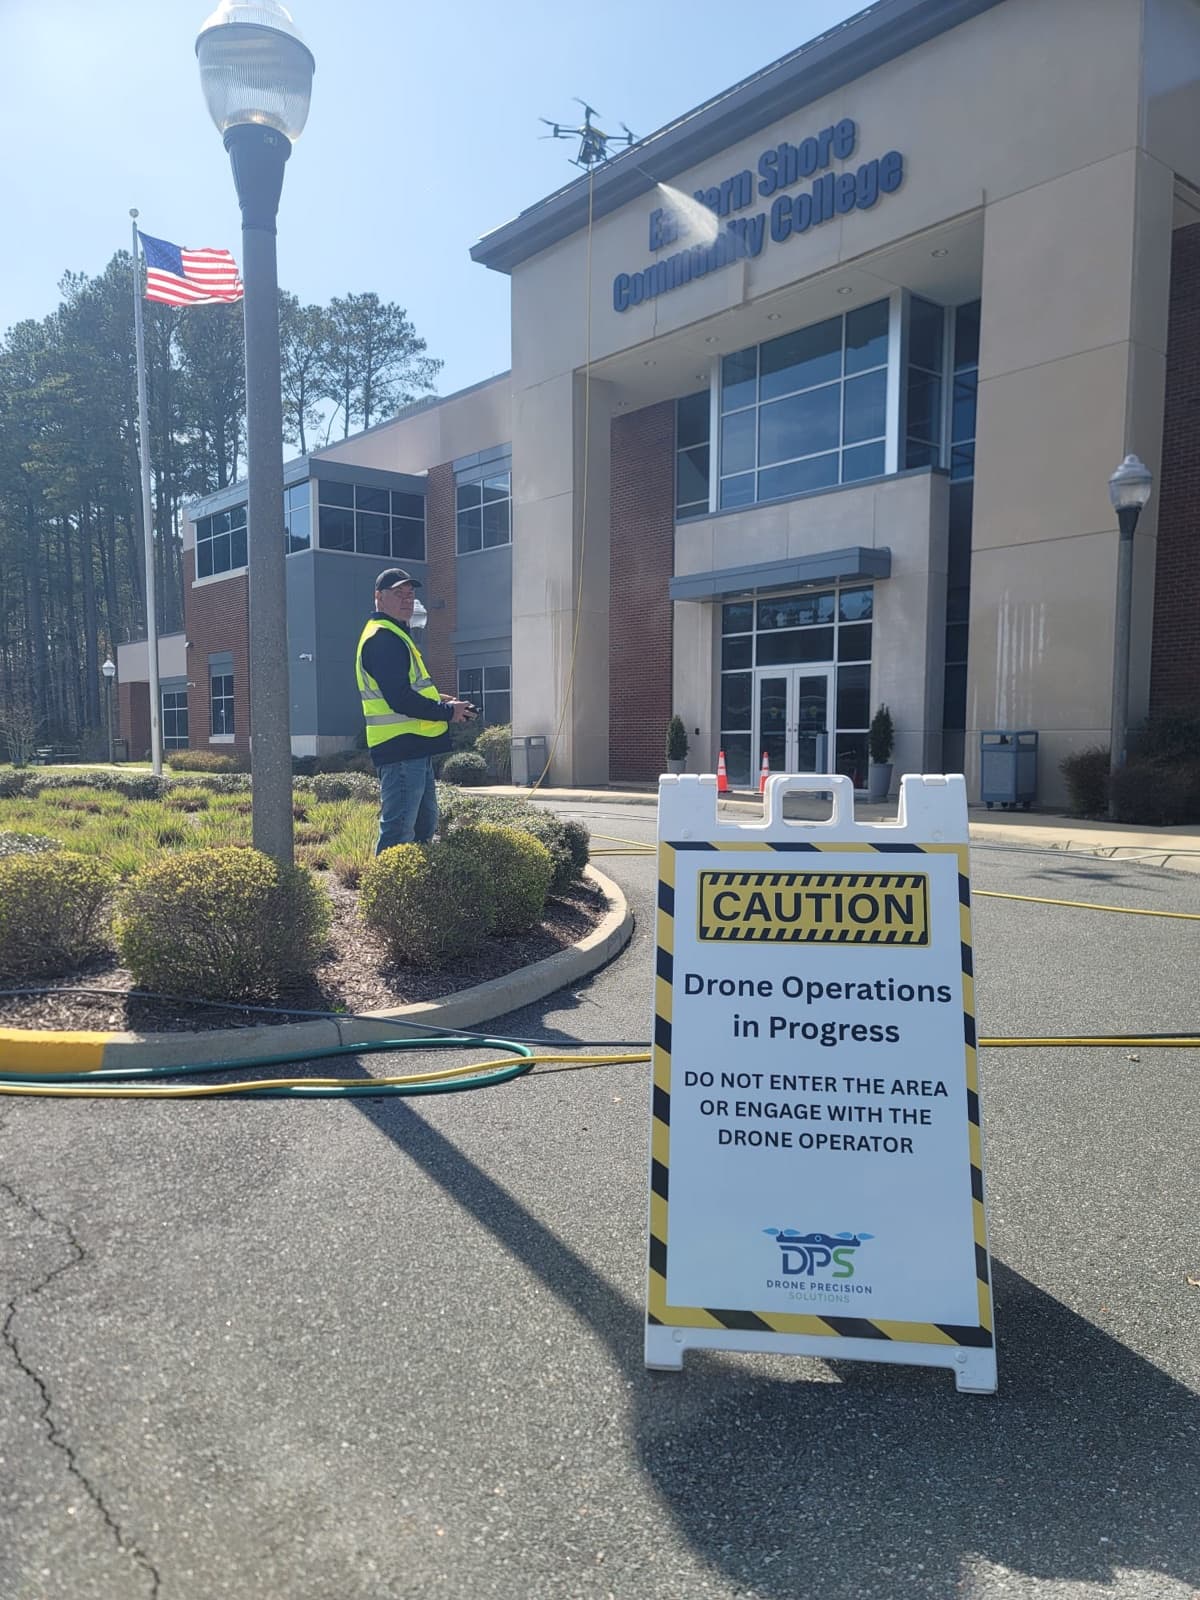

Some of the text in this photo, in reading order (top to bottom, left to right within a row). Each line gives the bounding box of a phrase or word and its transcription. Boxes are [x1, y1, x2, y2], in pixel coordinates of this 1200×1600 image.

[649, 117, 856, 252] Eaern Shore
[613, 150, 904, 313] Community College
[713, 891, 914, 925] CAUTION
[684, 973, 952, 1005] Drone Operations
[733, 1013, 900, 1047] in Progress
[684, 1070, 949, 1097] DO NOT ENTER THE AREA
[699, 1099, 932, 1126] OR ENGAGE WITH THE
[718, 1128, 914, 1154] DRONE OPERATOR
[779, 1245, 855, 1278] DPS
[766, 1279, 872, 1294] DRONE PRECISION
[788, 1291, 850, 1304] SOLUTIONS
